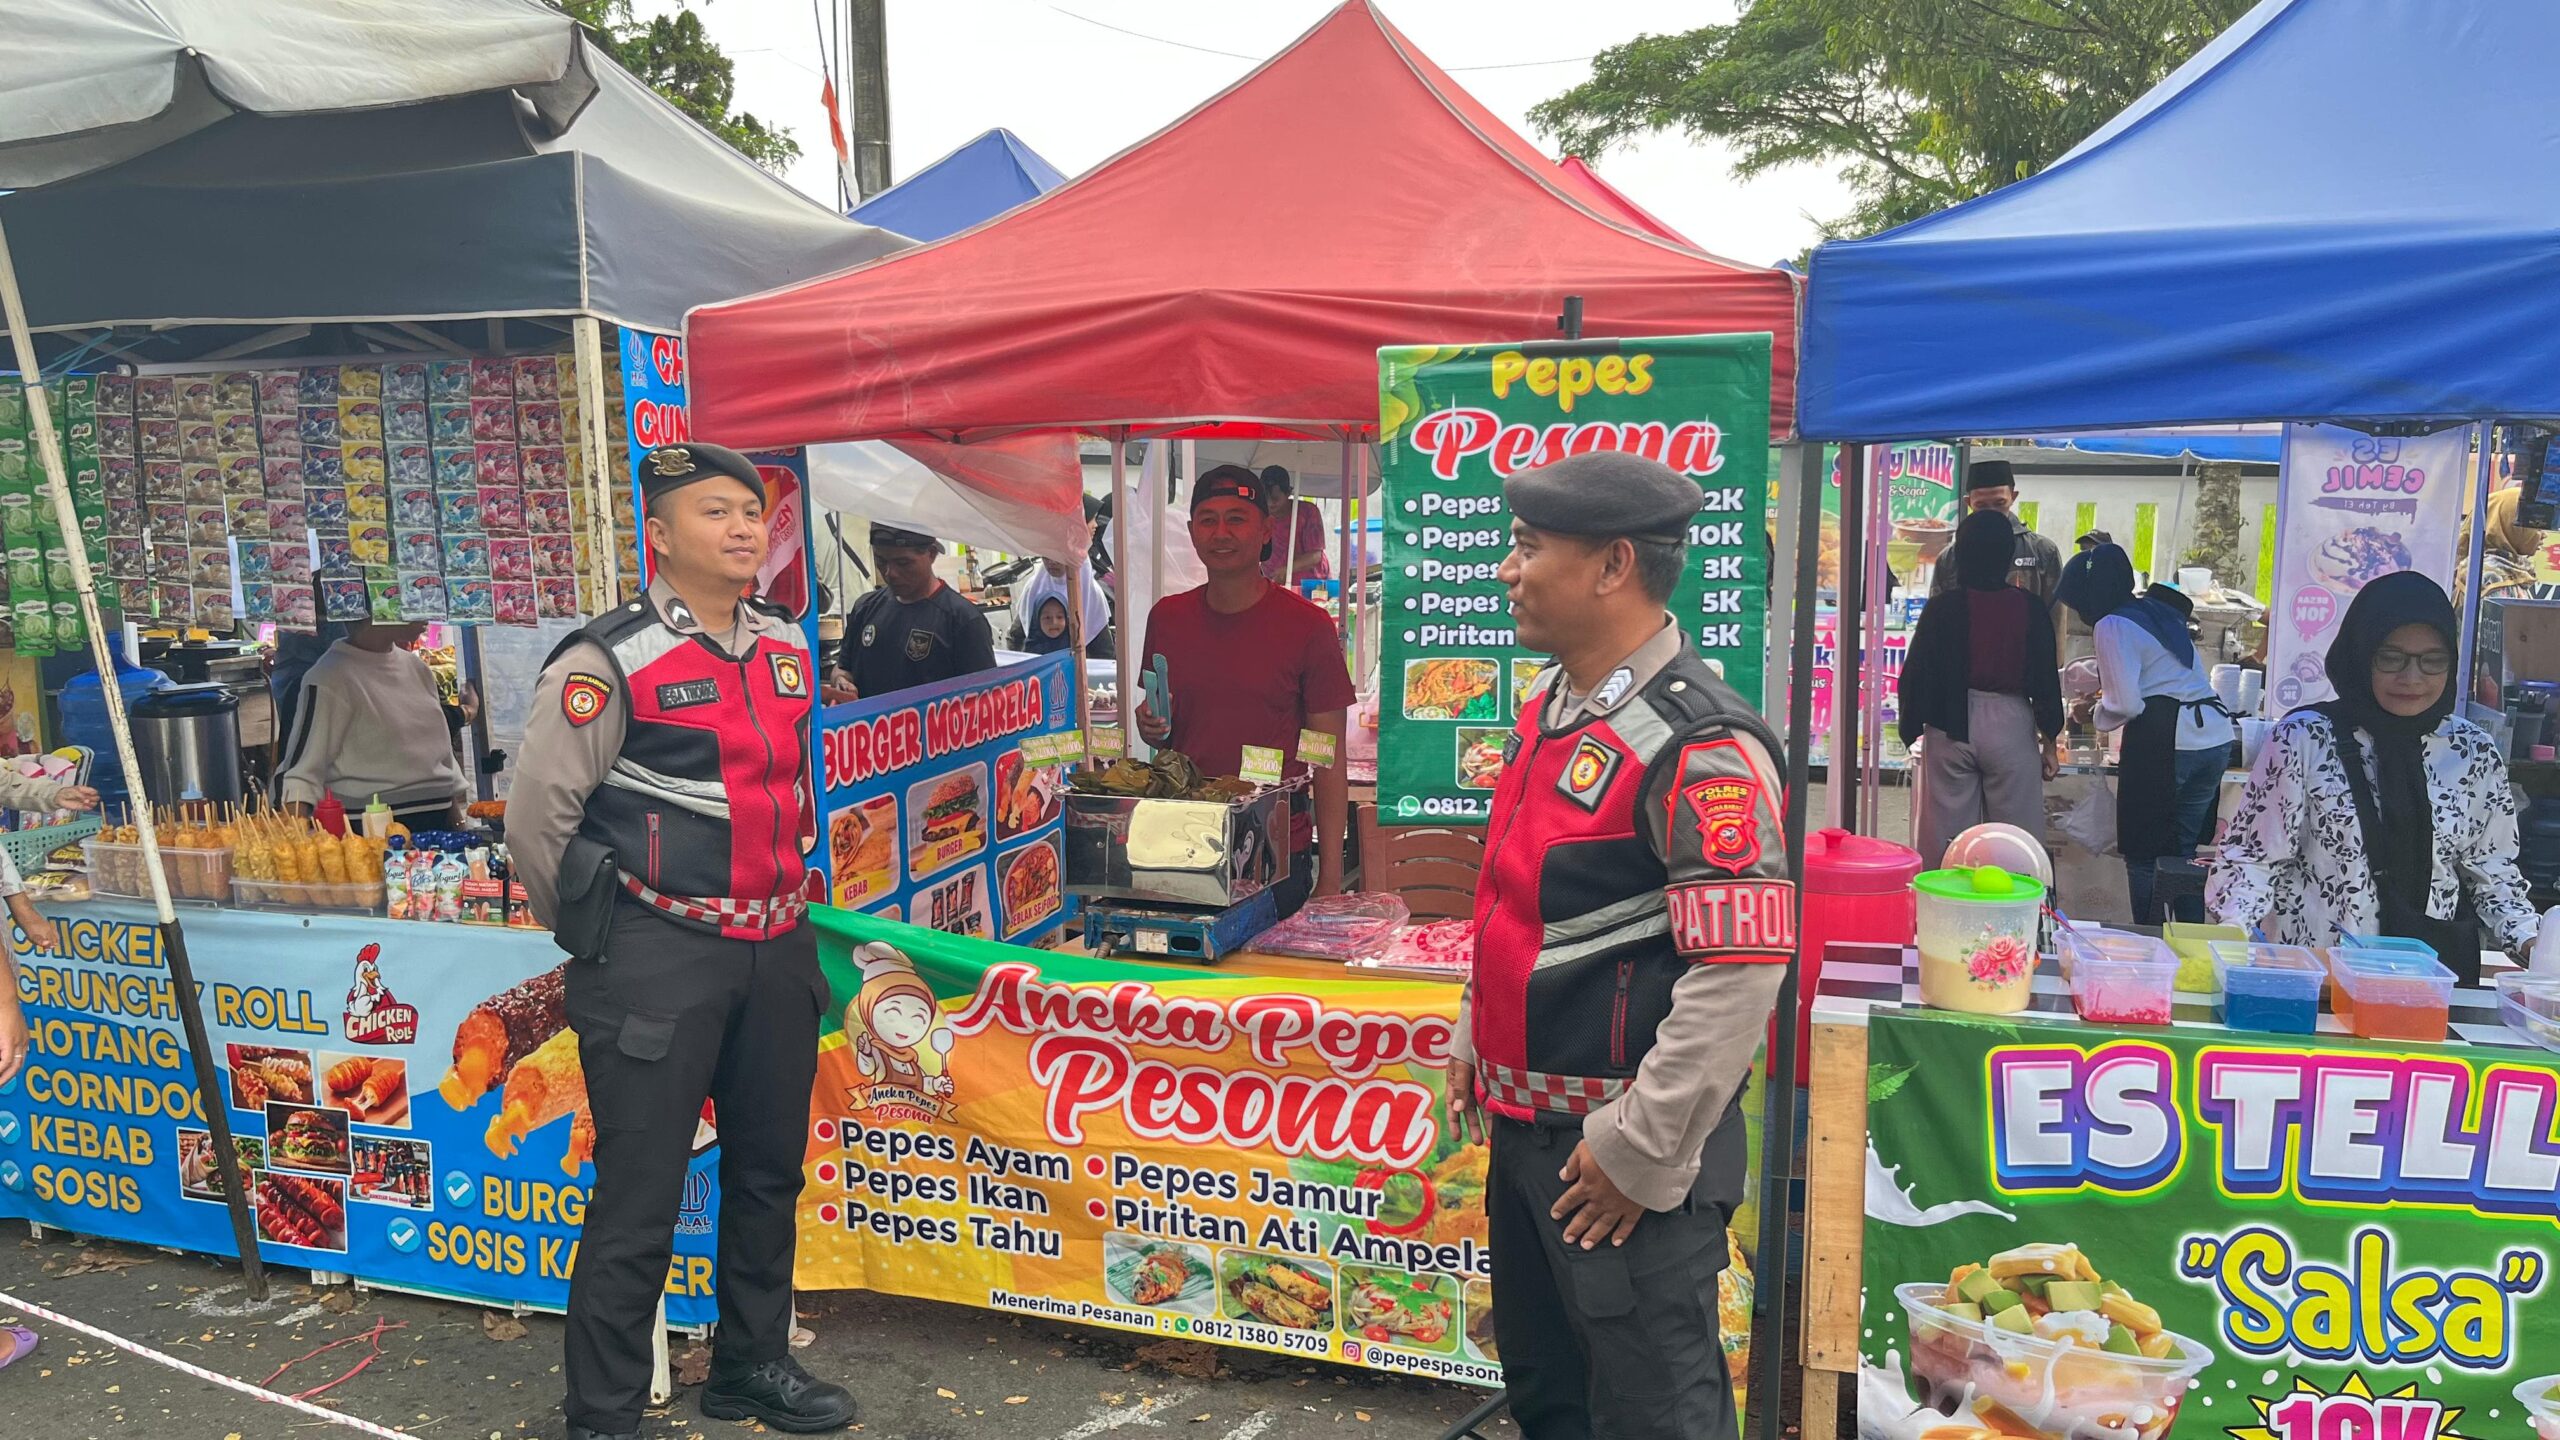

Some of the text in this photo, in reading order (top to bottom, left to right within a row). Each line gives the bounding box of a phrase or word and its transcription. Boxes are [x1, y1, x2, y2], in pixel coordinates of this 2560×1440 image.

[1491, 351, 1654, 413] Pepes
[1410, 406, 1726, 481] Pesona
[1906, 444, 1956, 490] Milk
[1421, 493, 1501, 519] Pepes
[1699, 488, 1744, 511] 2K
[1898, 484, 1929, 497] Segar
[1422, 522, 1743, 552] Pepes 10K
[1422, 556, 1743, 585] Pepes 3K
[1421, 590, 1742, 617] Pepes 5K
[1420, 623, 1741, 647] Piritan 5K
[823, 675, 1044, 794] BURGER MOZARELA
[1423, 797, 1478, 815] 0812
[1696, 785, 1747, 800] POLRES
[936, 838, 963, 862] BURGER
[843, 879, 869, 904] KEBAB
[18, 964, 329, 1035] CRUNCH ROLL
[346, 1008, 412, 1039] CHICKEN
[946, 963, 1231, 1054] Aneka
[385, 1026, 413, 1043] ROLL
[874, 1103, 933, 1124] Pesona
[906, 1089, 937, 1112] Pepes
[1027, 1032, 1437, 1168] Pesona
[30, 1114, 154, 1166] KEBAB
[840, 1119, 1071, 1182] Pepes Ayam
[1988, 1040, 2560, 1218] ES TELL
[32, 1164, 142, 1213] SOSIS
[484, 1175, 594, 1225] BURG
[844, 1160, 1049, 1215] Pepes Ikan
[1113, 1155, 1382, 1220] Pepes Jamur
[427, 1221, 527, 1275] SOSIS
[846, 1200, 1062, 1258] Pepes Tahu
[1114, 1198, 1491, 1276] Piritan Ati Ampela
[991, 1290, 1077, 1317] Menerima
[1081, 1302, 1155, 1328] Pesanan
[1191, 1319, 1234, 1340] 0812
[1237, 1325, 1279, 1346] 1380
[1283, 1332, 1329, 1353] 5709
